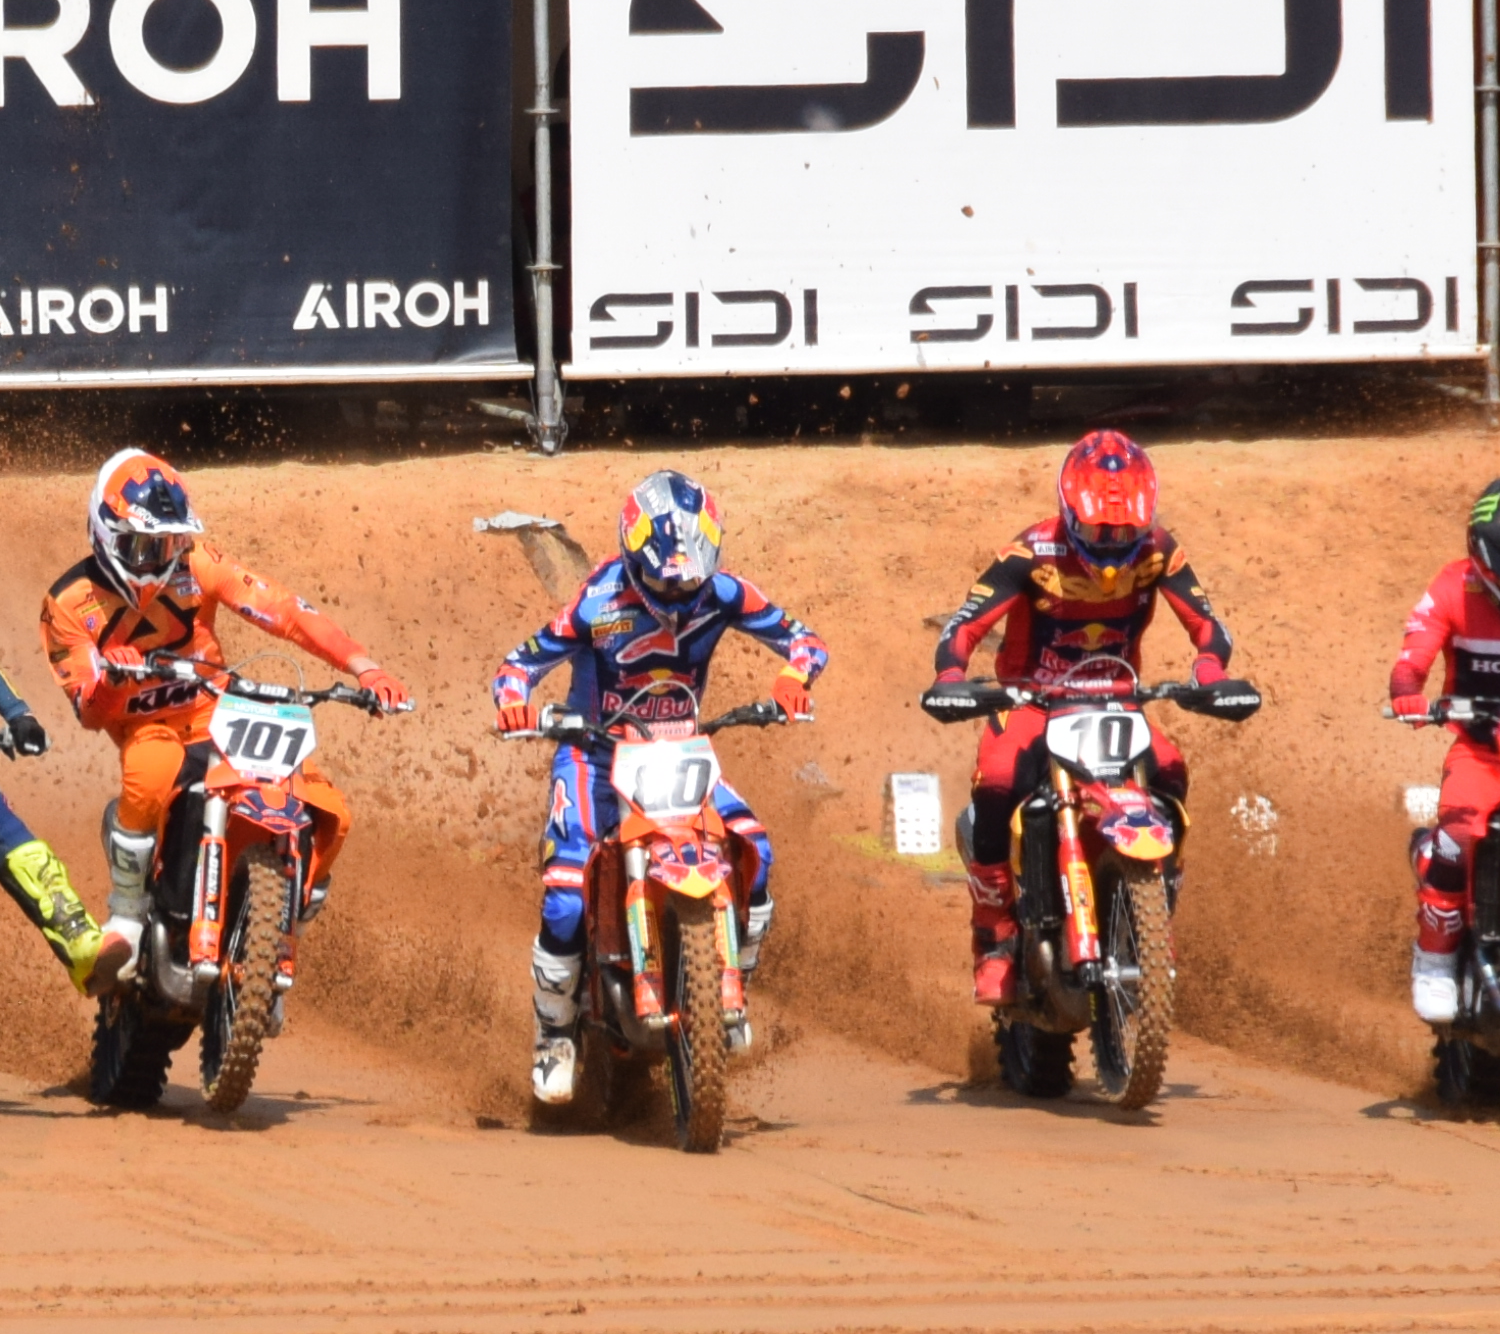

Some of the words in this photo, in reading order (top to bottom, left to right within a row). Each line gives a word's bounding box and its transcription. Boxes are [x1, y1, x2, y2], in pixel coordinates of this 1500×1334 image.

[292, 279, 490, 331] AIROH
[589, 288, 819, 350] SIDI
[909, 282, 1139, 345] SIDI
[1230, 275, 1459, 337] SIDI
[224, 717, 309, 768] 101
[1068, 715, 1134, 763] 10
